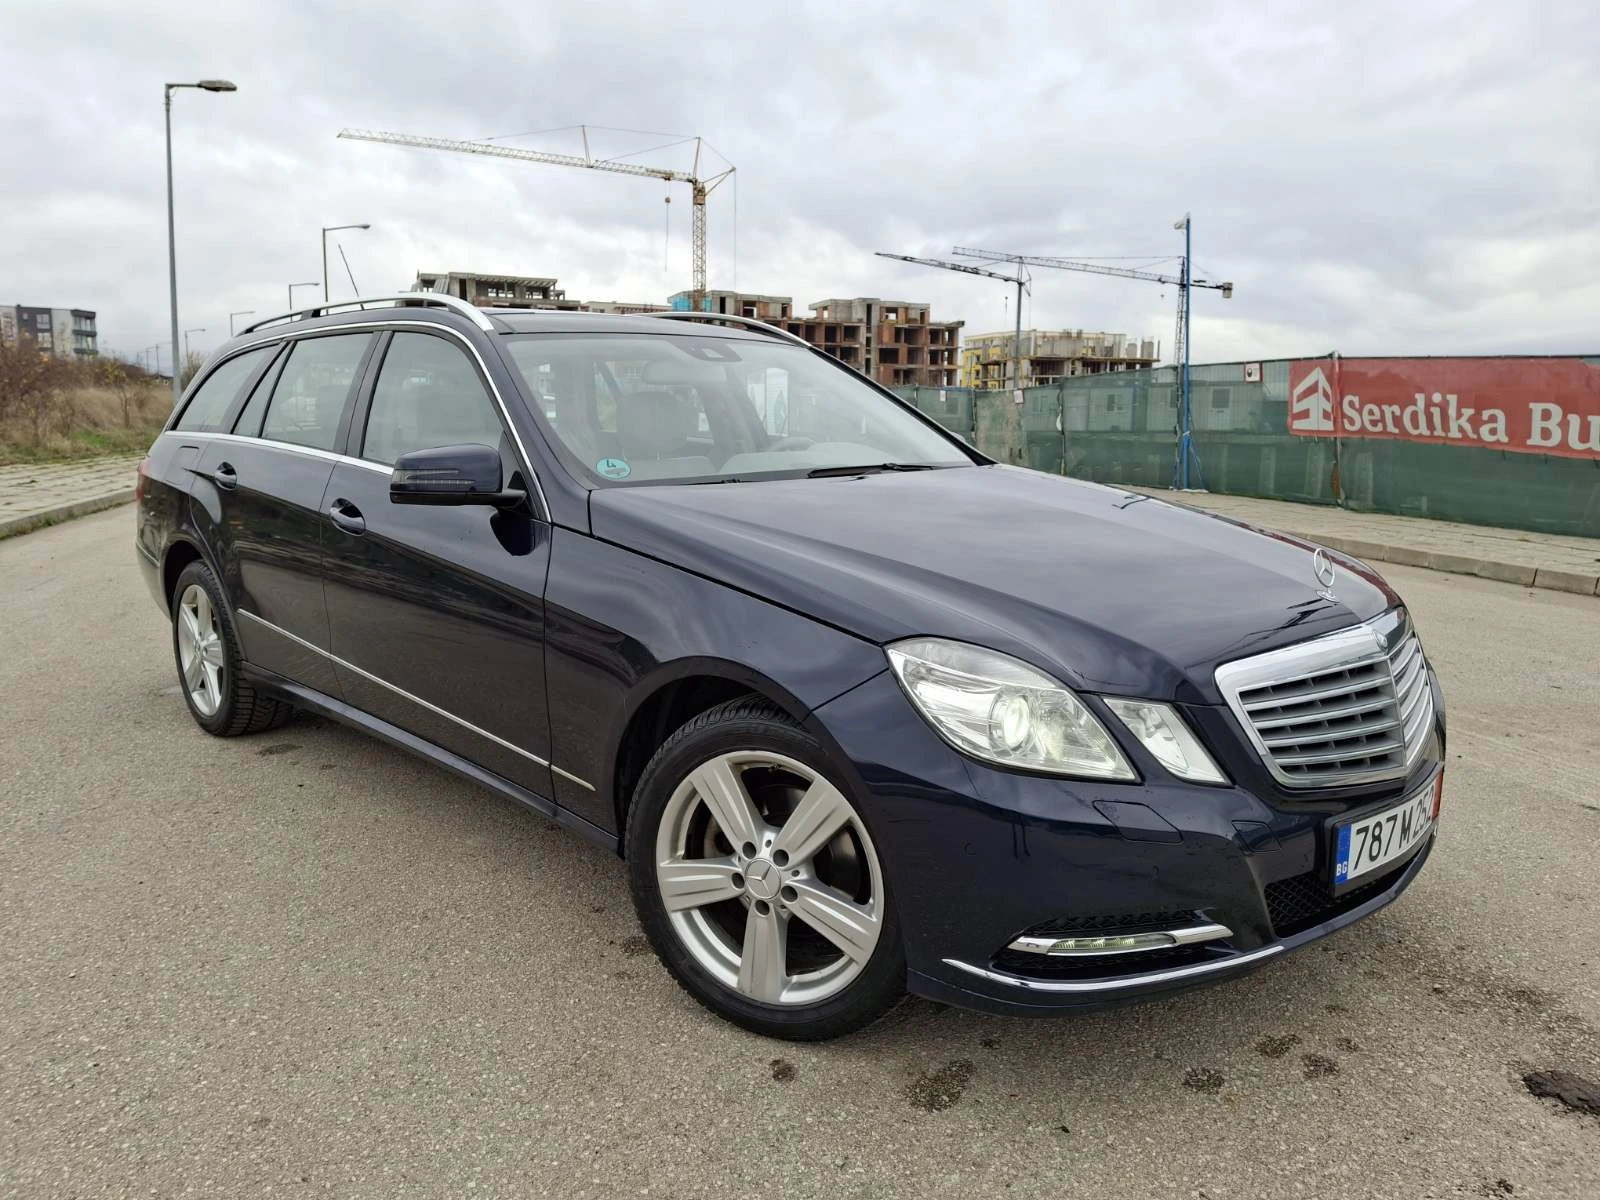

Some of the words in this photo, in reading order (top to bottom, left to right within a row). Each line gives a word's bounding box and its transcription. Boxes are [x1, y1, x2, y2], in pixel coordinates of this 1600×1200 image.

[1342, 393, 1509, 442] Serdika
[1527, 402, 1600, 450] Bu
[1336, 861, 1348, 876] BG
[1354, 814, 1398, 870] 787
